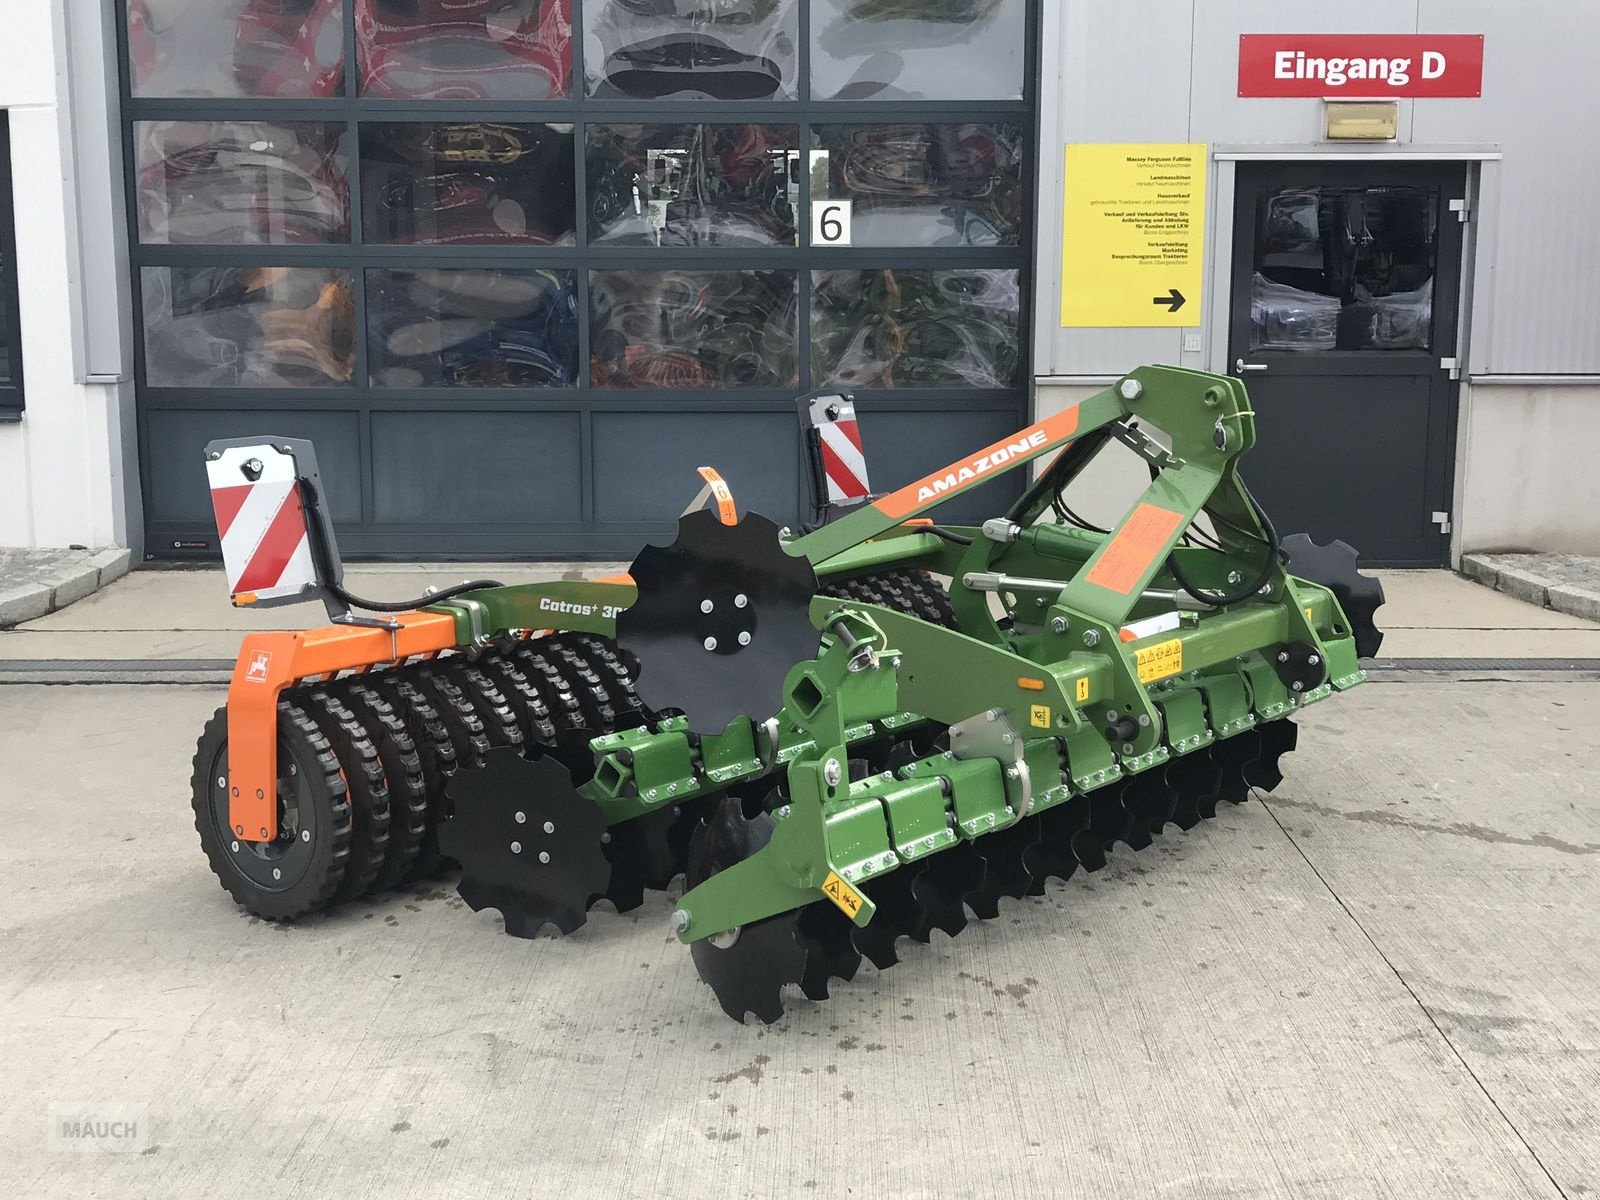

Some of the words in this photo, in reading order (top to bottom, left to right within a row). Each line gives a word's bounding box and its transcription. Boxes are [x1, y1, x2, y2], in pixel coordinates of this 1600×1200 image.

[1274, 51, 1411, 86] Eingang
[1421, 51, 1447, 79] D
[820, 206, 842, 241] 6
[918, 430, 1048, 502] AMAZONE
[716, 484, 728, 500] 6
